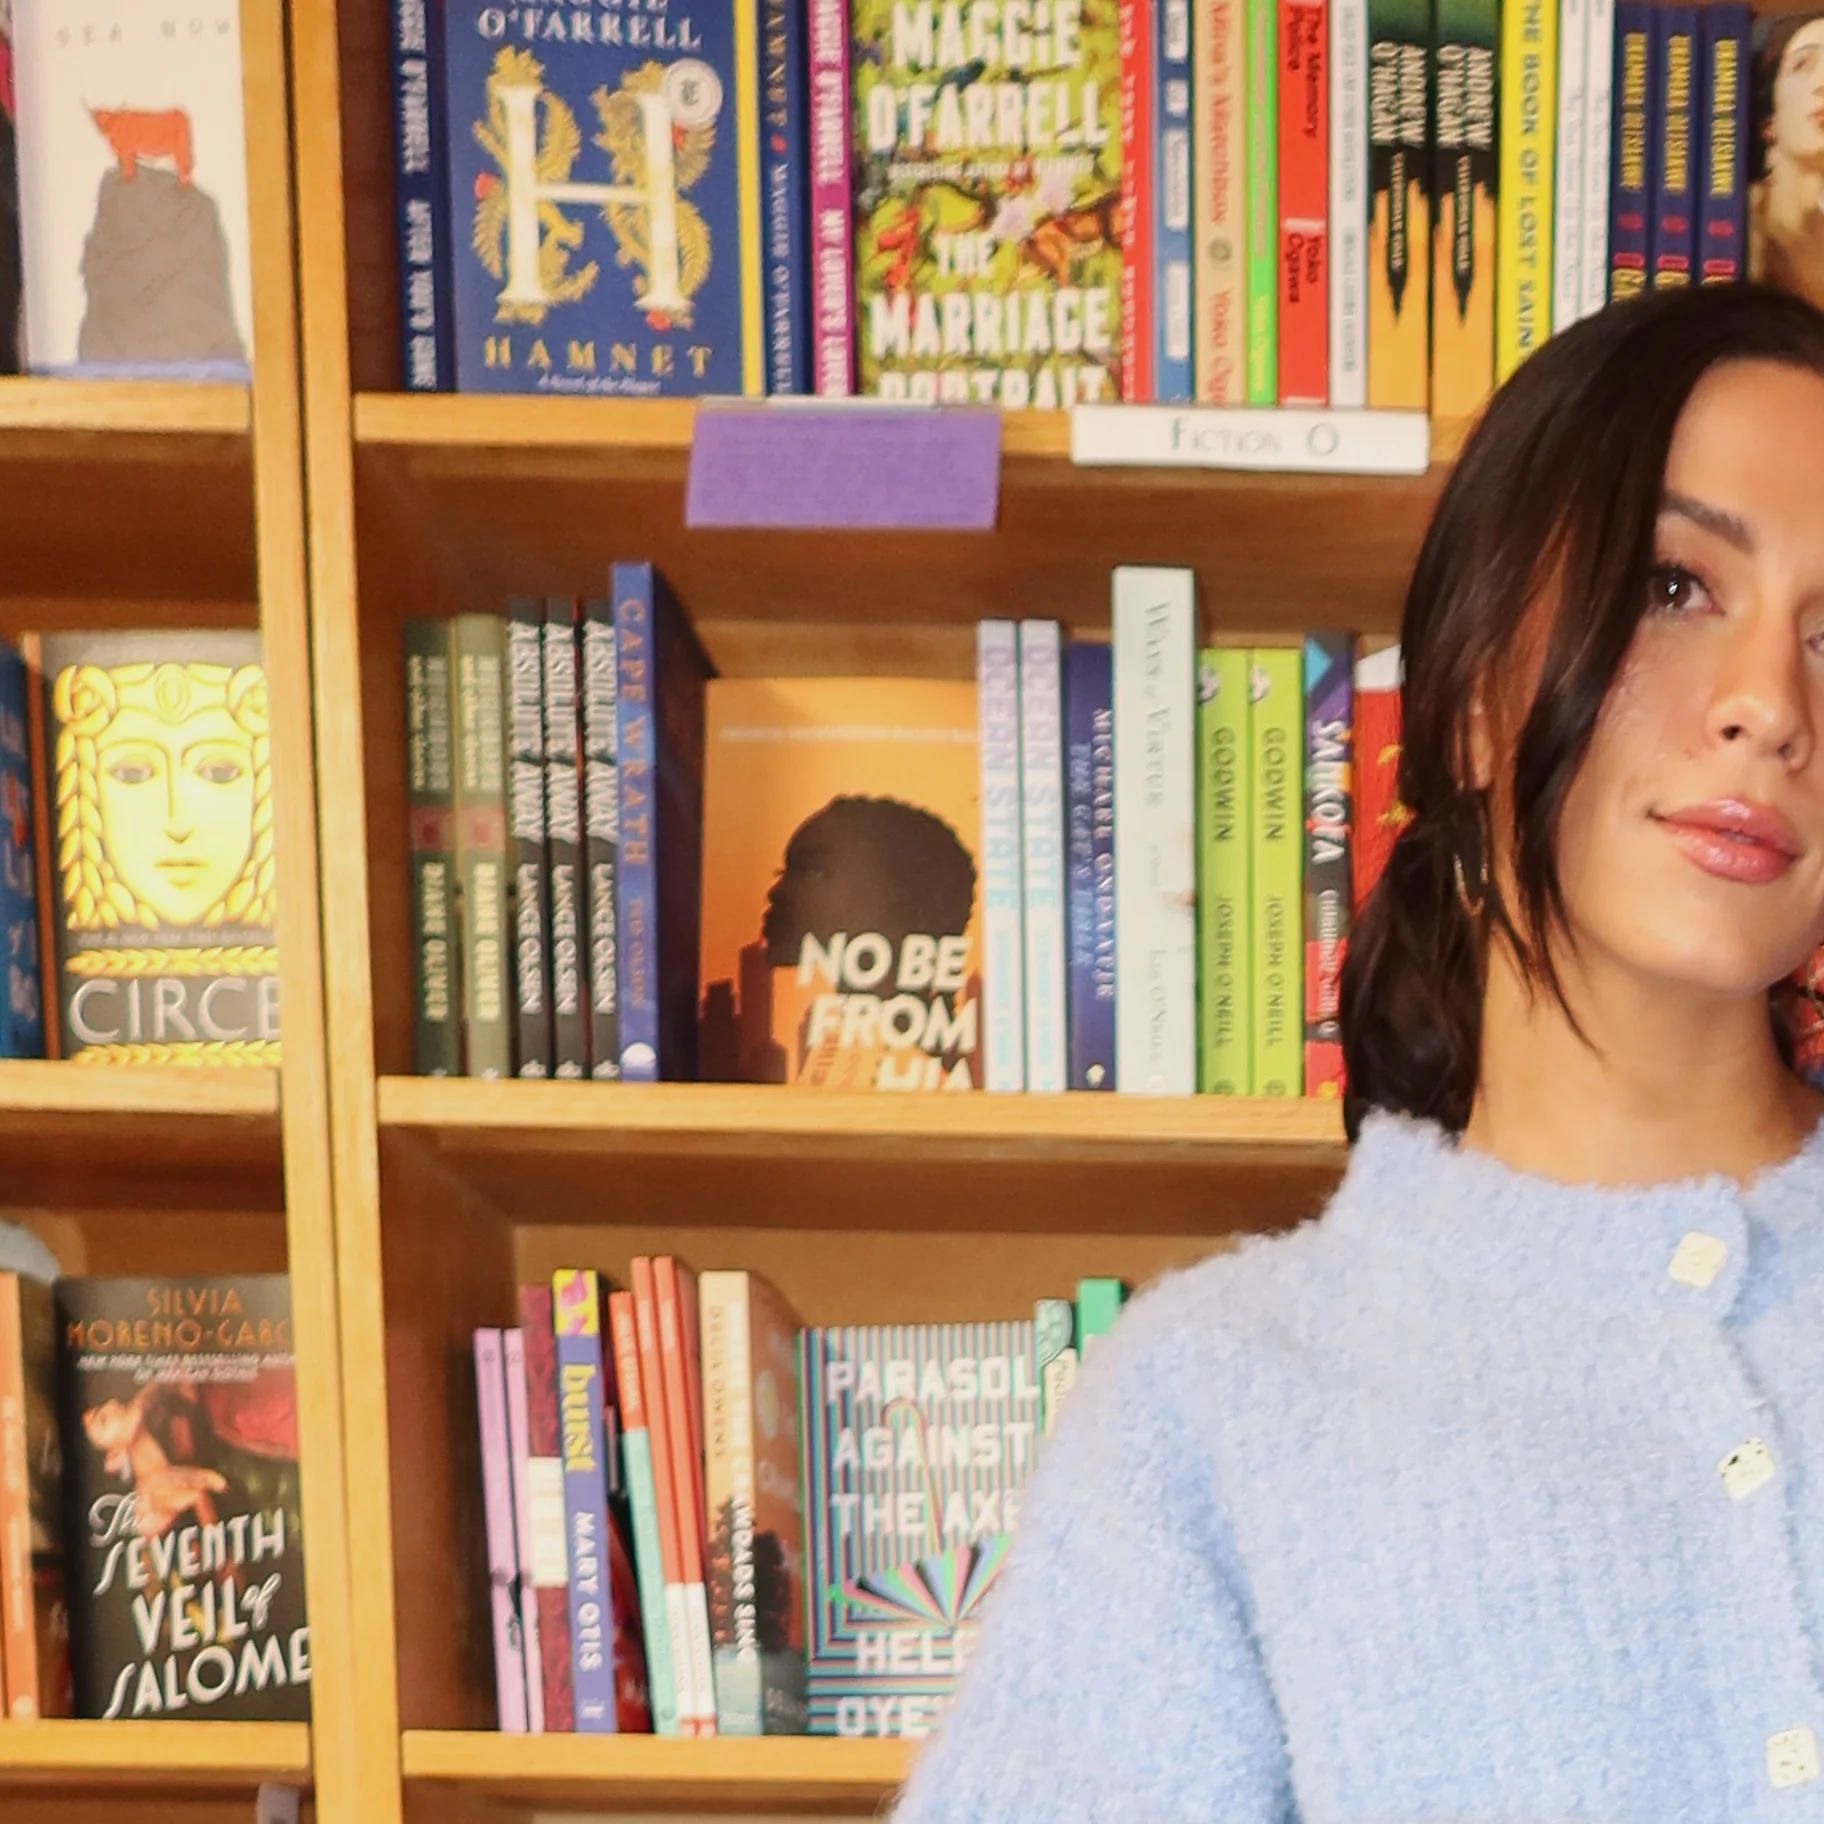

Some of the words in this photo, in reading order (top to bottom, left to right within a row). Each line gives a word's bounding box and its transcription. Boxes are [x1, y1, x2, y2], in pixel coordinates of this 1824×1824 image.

[478, 8, 703, 50] O'FARRELL
[894, 3, 1082, 66] MAGGIE
[1286, 5, 1303, 71] Police
[869, 85, 1109, 147] O'FARRELL
[1302, 51, 1323, 138] Memory
[1371, 42, 1398, 142] O'HAGAN
[1399, 46, 1428, 143] ANDREW
[1437, 45, 1464, 143] O'HAGAN
[1465, 47, 1493, 145] ANDREW
[1521, 54, 1541, 135] BOOK
[1520, 149, 1541, 185] OF
[935, 236, 996, 273] THE
[1306, 235, 1323, 283] Yoko
[1519, 196, 1541, 264] LOST
[1285, 232, 1302, 303] Ogawa
[486, 336, 713, 377] HAMNET
[873, 290, 1110, 357] MARRIAGE
[1172, 417, 1281, 455] FICTION
[1305, 422, 1340, 456] O
[618, 599, 646, 702] CAPE
[508, 762, 542, 843] AWAY
[544, 762, 579, 843] AWAY
[584, 762, 619, 843] AWAY
[620, 717, 648, 864] WRATH
[1212, 728, 1237, 842] GODWIN
[1263, 728, 1287, 842] GODWIN
[1312, 720, 1345, 863] SANKOFA
[516, 862, 539, 935] LANCE
[552, 862, 575, 935] LANCE
[593, 862, 614, 935] LANCE
[1215, 896, 1234, 964] JOSEPH
[1265, 896, 1285, 964] JOSEPH
[517, 938, 541, 1014] OLSEN
[553, 938, 577, 1014] OLSEN
[798, 932, 892, 992] NO
[899, 935, 972, 993] BE
[68, 977, 280, 1045] CIRCE
[805, 994, 978, 1050] FROM
[1215, 973, 1235, 1047] O'NEILL
[1265, 973, 1286, 1047] O'NEILL
[146, 1288, 243, 1319] SILVIA
[826, 1356, 1039, 1403] PARASOL
[560, 1364, 597, 1472] burst
[833, 1421, 1037, 1470] AGAINST
[831, 1491, 926, 1535] THE
[94, 1508, 286, 1595] SEVENTH
[573, 1513, 600, 1595] MARY
[131, 1583, 244, 1654] VEIL
[242, 1573, 281, 1626] of
[577, 1602, 603, 1670] OTIS
[103, 1625, 310, 1719] SALOME
